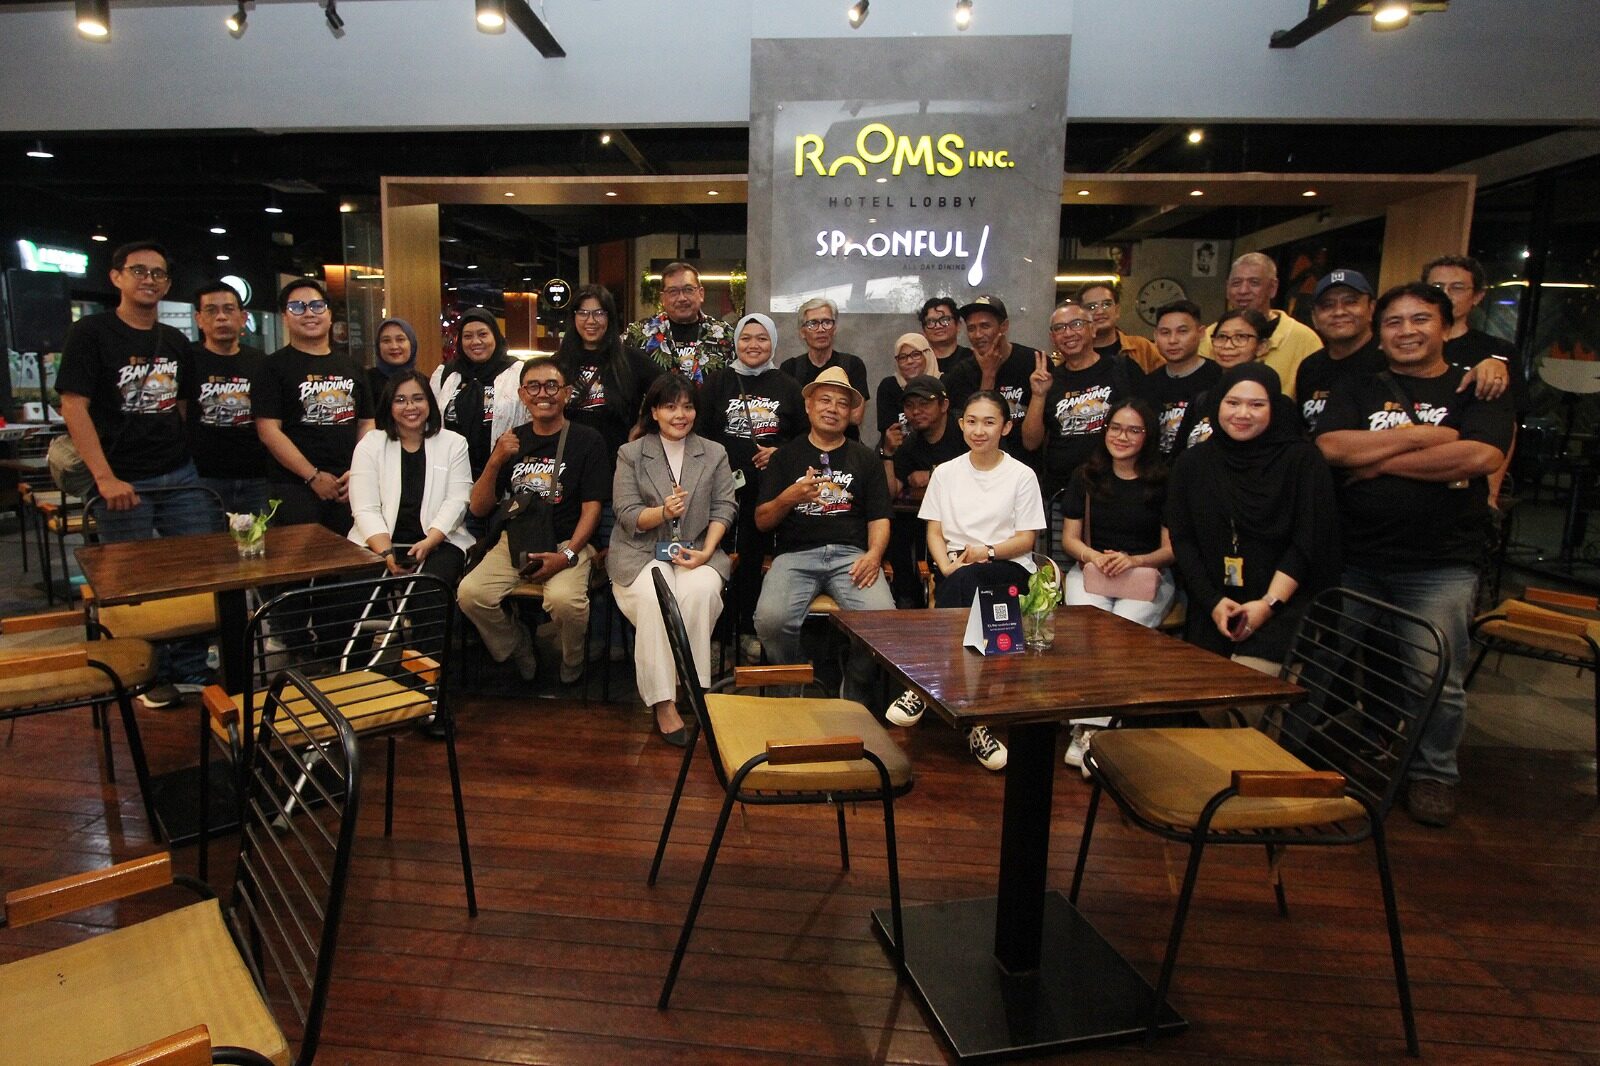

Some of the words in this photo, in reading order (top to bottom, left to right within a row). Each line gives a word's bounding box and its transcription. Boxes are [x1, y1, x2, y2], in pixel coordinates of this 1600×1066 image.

[795, 123, 965, 177] ROOMS
[968, 150, 1015, 168] INC.
[829, 196, 894, 208] HOTEL
[909, 196, 977, 208] LOBBY
[198, 382, 251, 402] BANDUN
[299, 379, 355, 402] BANDUNG
[1055, 386, 1112, 418] BANDUNG
